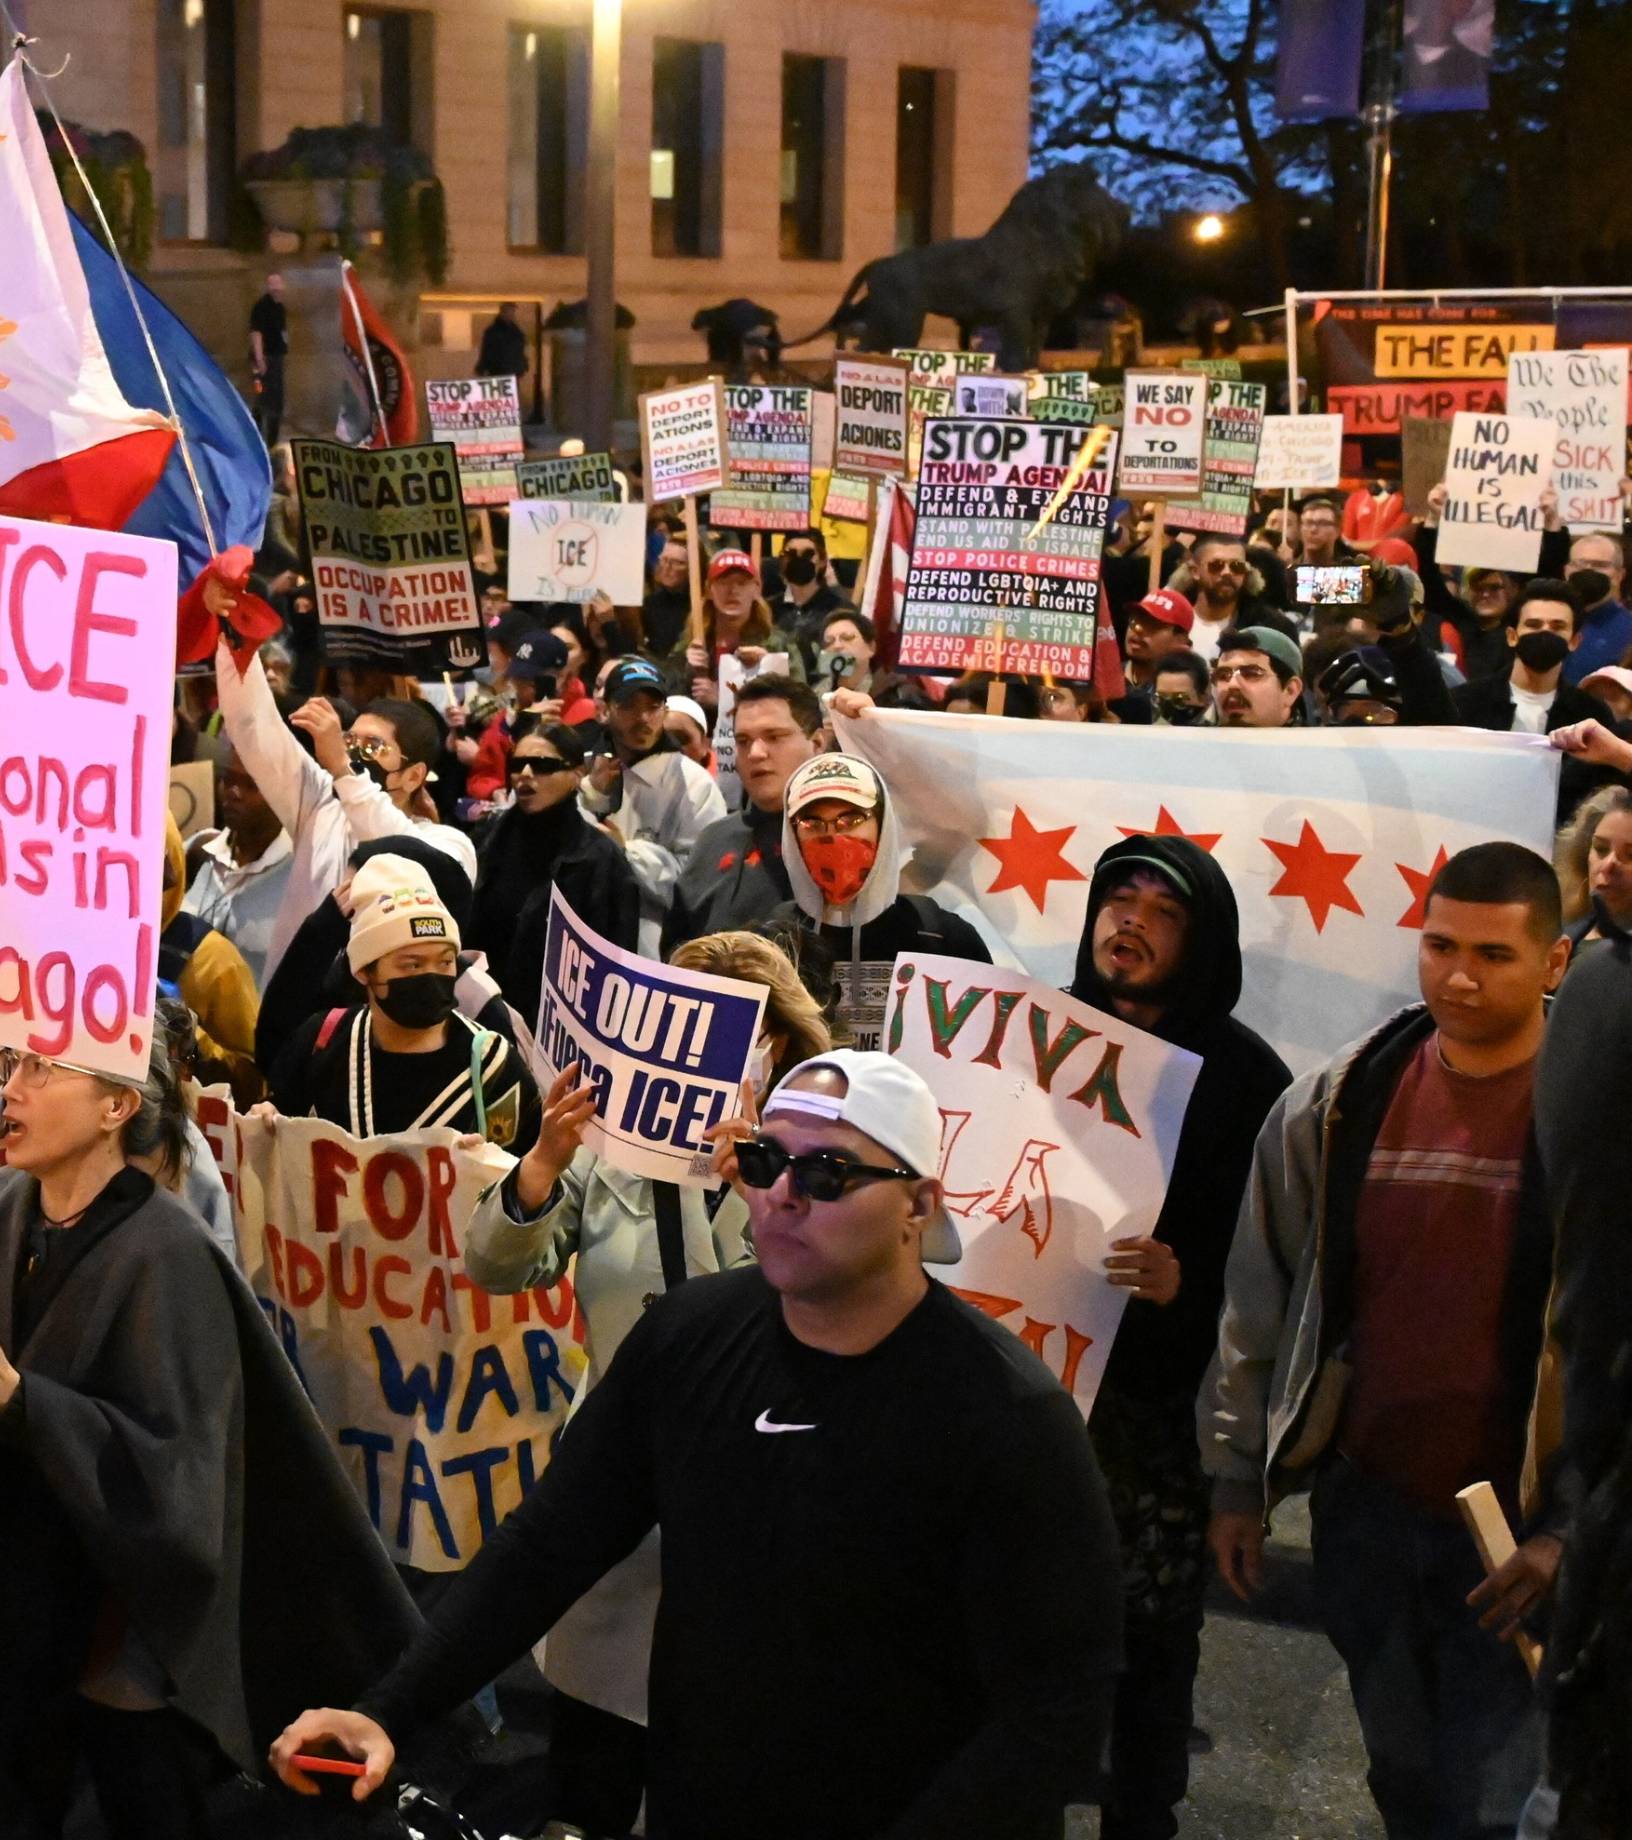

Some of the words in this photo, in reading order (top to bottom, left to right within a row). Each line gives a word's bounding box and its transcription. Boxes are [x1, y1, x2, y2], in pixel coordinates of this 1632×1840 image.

[1384, 336, 1455, 369] THE
[429, 383, 471, 401] STOP
[478, 379, 513, 399] THE
[1044, 374, 1083, 397] THE
[1136, 384, 1160, 405] WE
[1164, 384, 1194, 406] SAY
[1228, 385, 1262, 407] THE
[651, 401, 680, 416] NO
[685, 393, 711, 409] TO
[725, 388, 763, 410] TOP
[769, 388, 808, 411] THE
[841, 385, 903, 415] DEPORT
[1329, 391, 1454, 424] TRUMP
[652, 408, 710, 428] DEPORT
[1135, 407, 1192, 425] NO
[653, 420, 713, 441] ATIONS
[840, 422, 902, 451] ACIONES
[1474, 420, 1509, 444] NO
[301, 446, 342, 465] FROM
[654, 448, 715, 468] DEPORT
[928, 423, 1027, 462] STOP
[1041, 428, 1111, 469] THE
[1145, 440, 1177, 453] TO
[1554, 440, 1614, 471] SICK
[655, 458, 717, 479] ACIONES
[925, 463, 997, 484] TRUMP
[1124, 455, 1198, 470] DEPORTATIONS
[1454, 448, 1538, 475] HUMAN
[303, 466, 454, 510] CHICAGO
[522, 467, 609, 498] CHICAGO
[1478, 477, 1502, 497] IS
[1559, 472, 1598, 491] this
[920, 487, 994, 501] DEFEND
[1006, 489, 1018, 503] &
[1032, 492, 1109, 511] EXPAND
[434, 509, 457, 525] TO
[528, 504, 559, 534] NO
[918, 520, 969, 534] STAND
[976, 521, 1013, 535] WITH
[919, 503, 1027, 519] IMMIGRANT
[1040, 505, 1107, 527] RIGHTS
[1443, 500, 1545, 532] ILLEGAL
[311, 525, 465, 562] PALESTINE
[558, 538, 587, 567] ICE
[917, 535, 945, 547] END
[955, 535, 974, 548] US
[981, 535, 1009, 548] AID
[1020, 537, 1038, 550] TO
[1046, 540, 1098, 558] ISRAEL
[912, 552, 957, 566] STOP
[967, 555, 1028, 569] POLICE
[1037, 559, 1098, 577] CRIMES
[318, 566, 467, 598] OCCUPATION
[910, 570, 971, 586] DEFEND
[979, 573, 1060, 590] LGBTQIA+
[1064, 582, 1097, 597] AND
[323, 594, 348, 617] IS
[359, 596, 372, 623] A
[378, 598, 470, 628] CRIME!
[907, 586, 1031, 606] REPRODUCTIVE
[1039, 594, 1095, 612] RIGHTS
[906, 603, 953, 617] DEFEND
[958, 605, 1025, 622] WORKERS'
[1029, 612, 1072, 626] RIGHTS
[1078, 616, 1092, 628] TO
[903, 618, 993, 635] UNIONIZE
[1006, 628, 1017, 638] &
[1029, 627, 1092, 645] STRIKE
[902, 636, 965, 653] DEFEND
[974, 640, 1072, 661] EDUCATION
[1079, 651, 1090, 662] &
[899, 650, 997, 669] ACADEMIC
[1005, 658, 1089, 677] FREEDOM
[71, 827, 142, 920] in
[415, 924, 444, 935] PARK
[558, 929, 595, 1020] ICE
[596, 973, 715, 1068] OUT!
[888, 963, 1142, 1139] ¡VIVA
[936, 1108, 1062, 1261] LA
[311, 1138, 460, 1258] FOR
[369, 1325, 575, 1435] WAR
[339, 1427, 536, 1560] TATI
